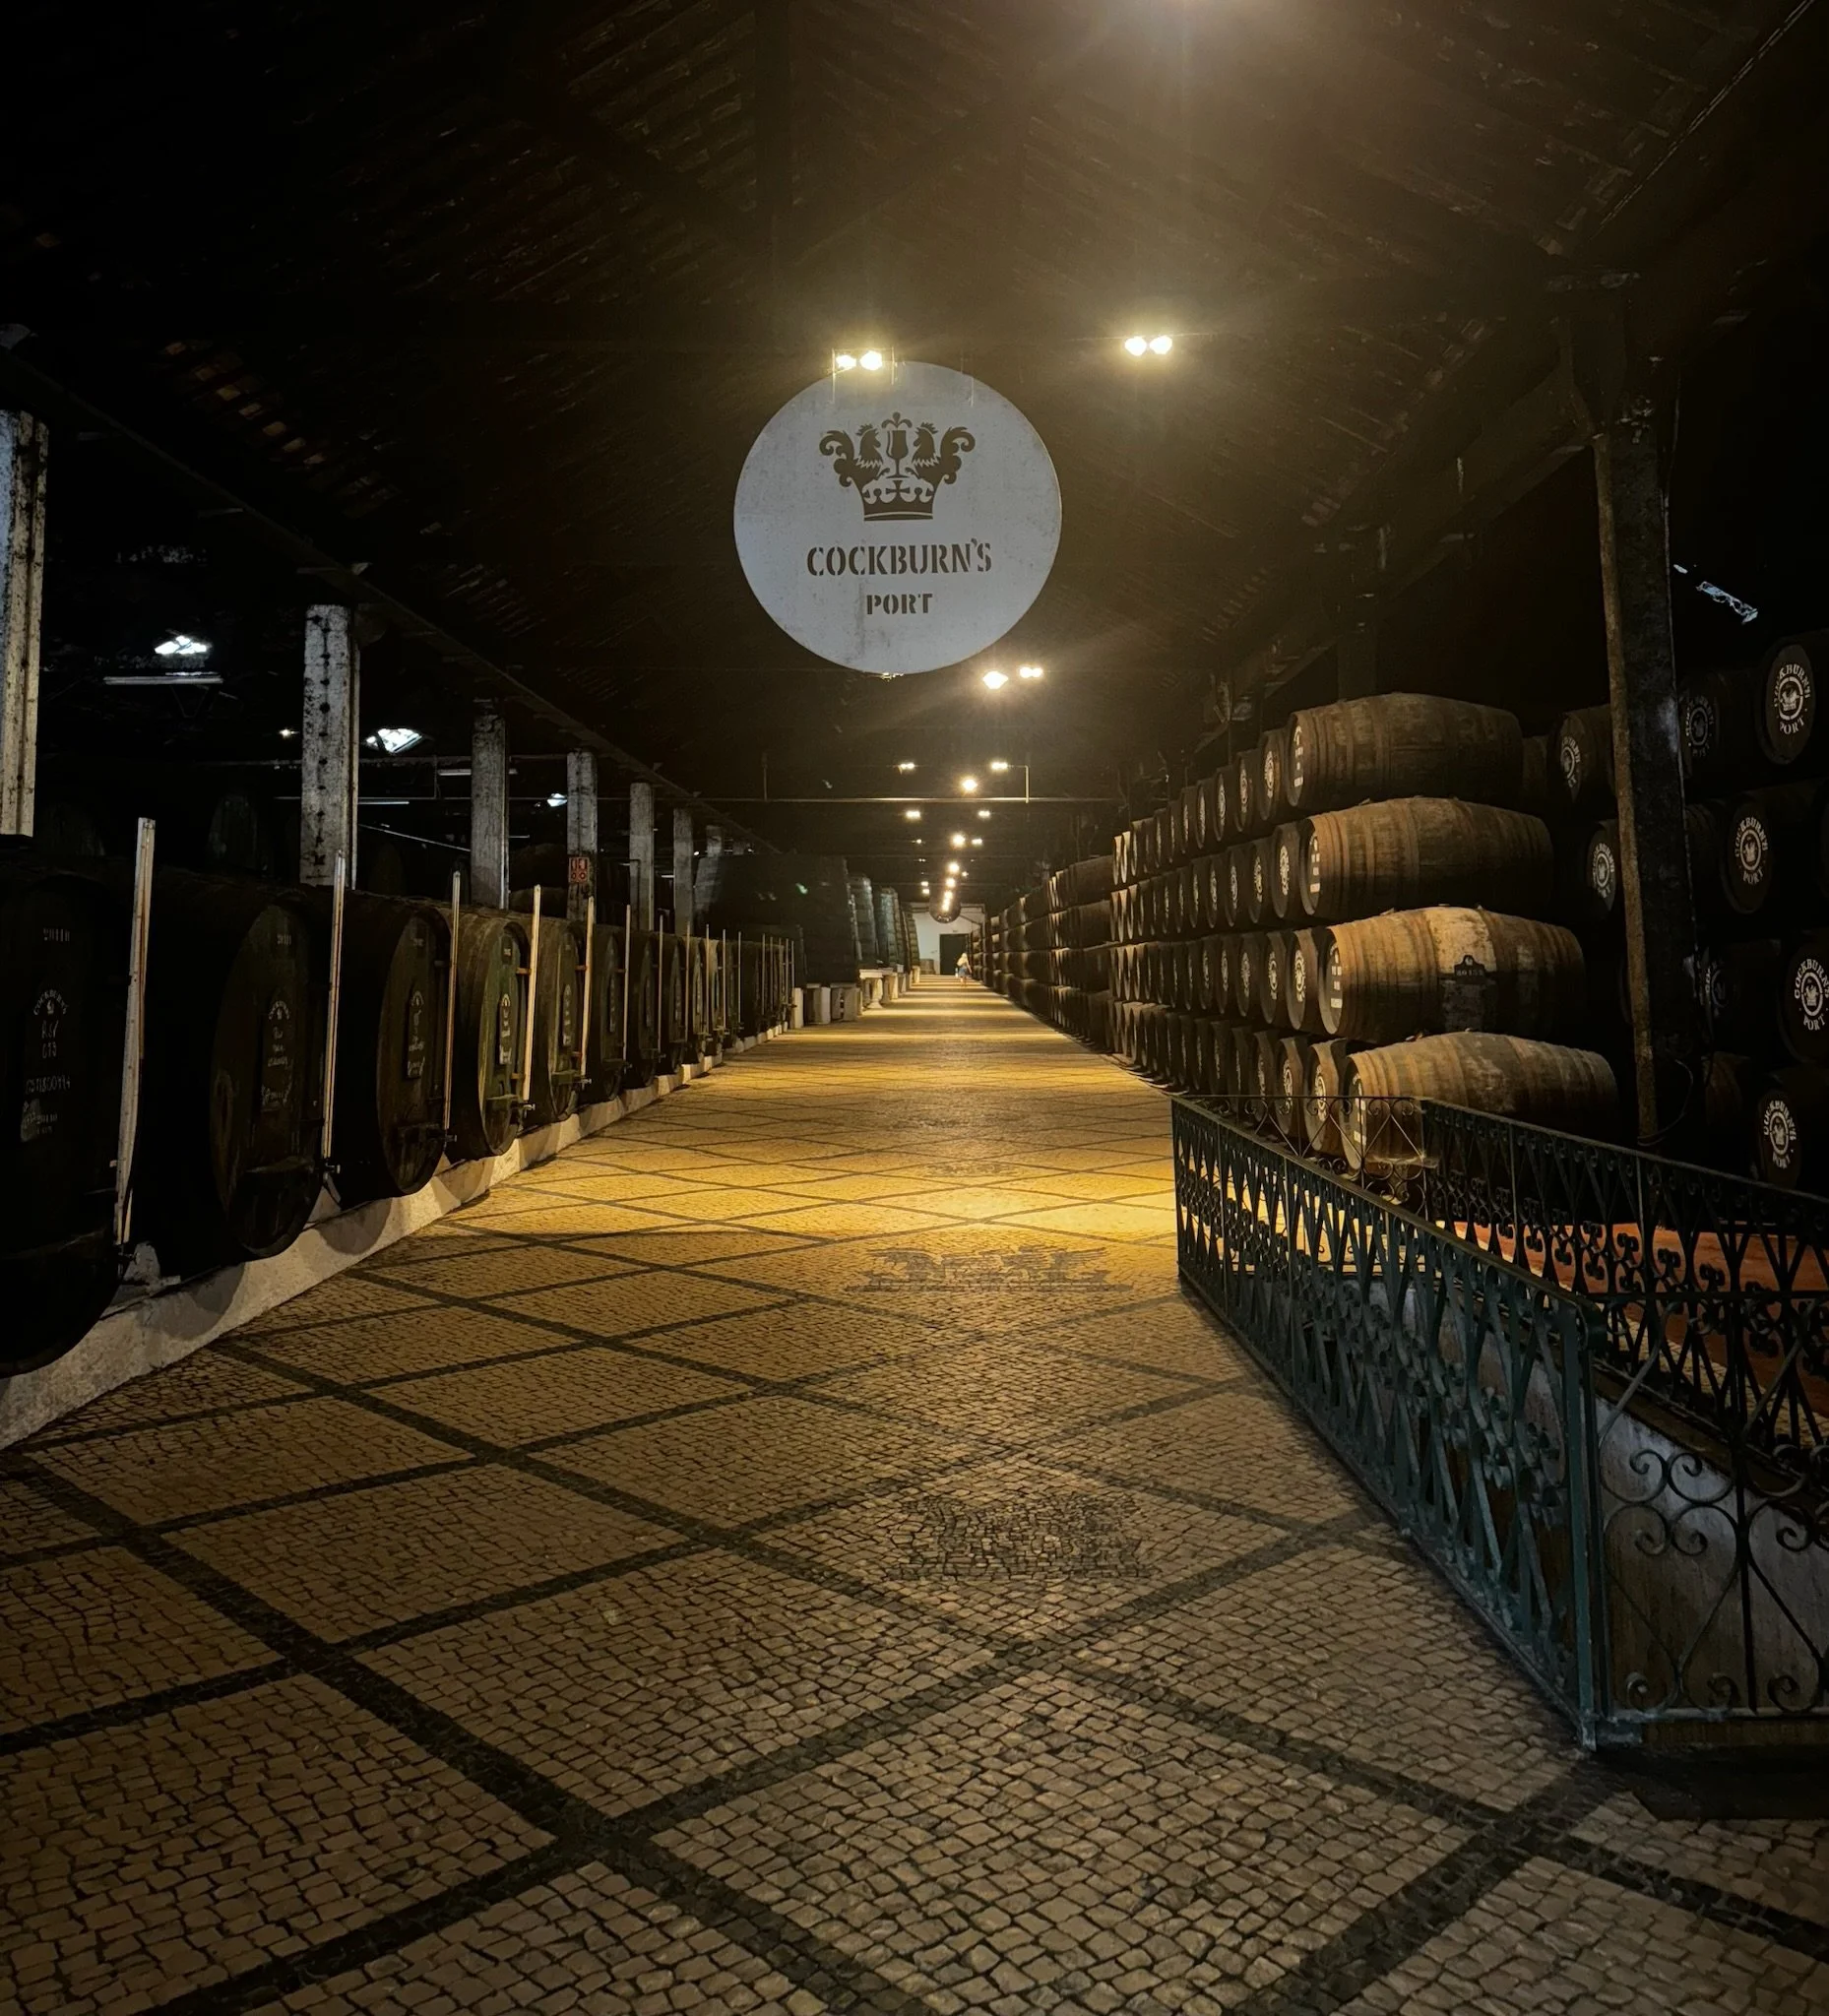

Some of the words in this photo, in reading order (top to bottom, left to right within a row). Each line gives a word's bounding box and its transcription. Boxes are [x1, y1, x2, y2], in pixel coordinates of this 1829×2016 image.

[807, 537, 991, 576] COCKBURN'S
[866, 593, 932, 615] PORT
[1780, 716, 1804, 735] PORT
[1742, 866, 1763, 885] PORT
[1803, 1013, 1825, 1031] PORT
